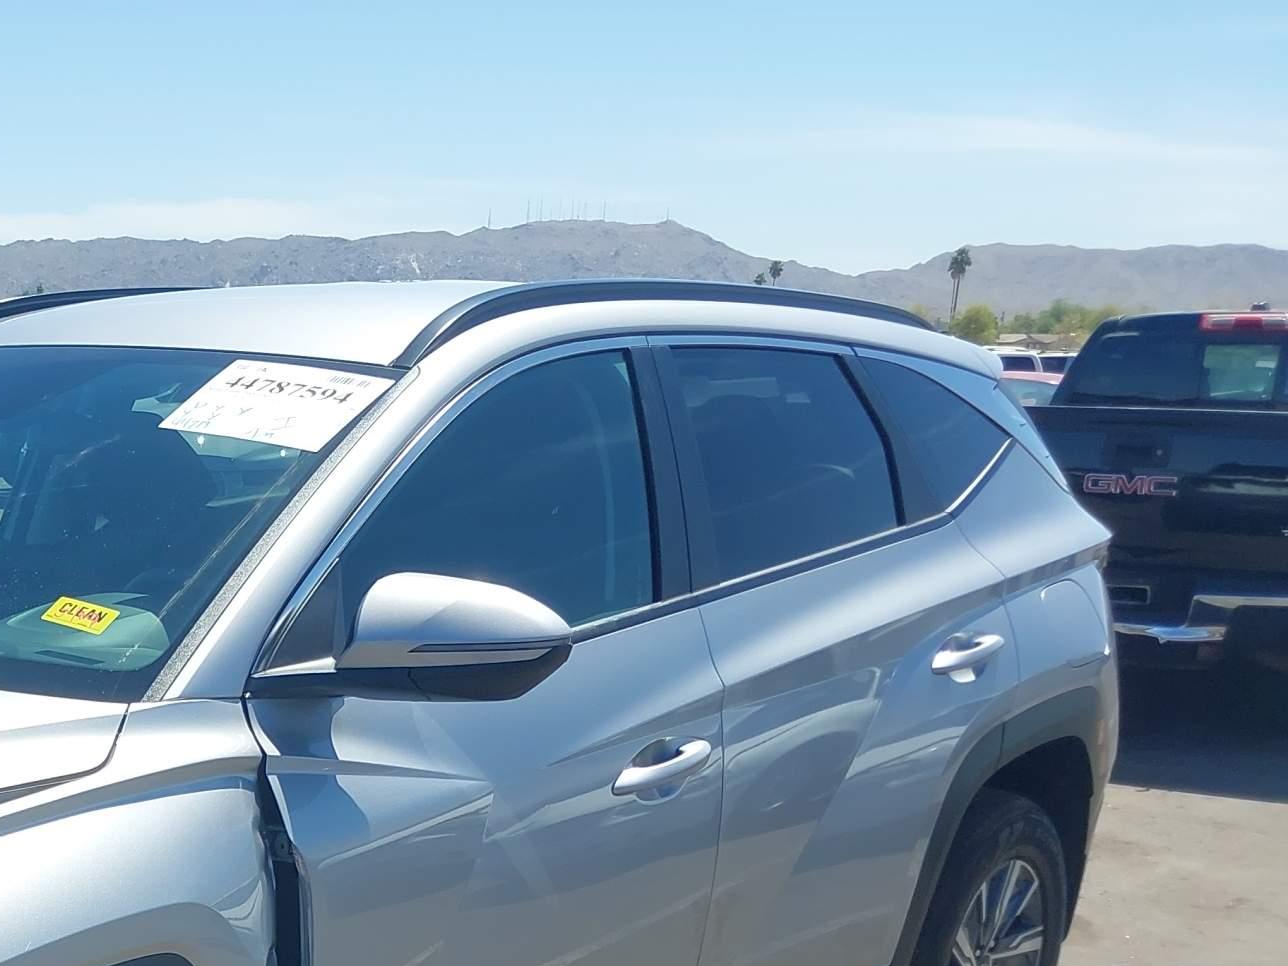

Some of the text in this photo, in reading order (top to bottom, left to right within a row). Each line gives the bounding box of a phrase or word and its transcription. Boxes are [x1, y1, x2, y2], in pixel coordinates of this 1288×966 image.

[225, 375, 354, 404] 44787594
[1083, 473, 1178, 496] GMC
[58, 602, 108, 623] CLEAN
